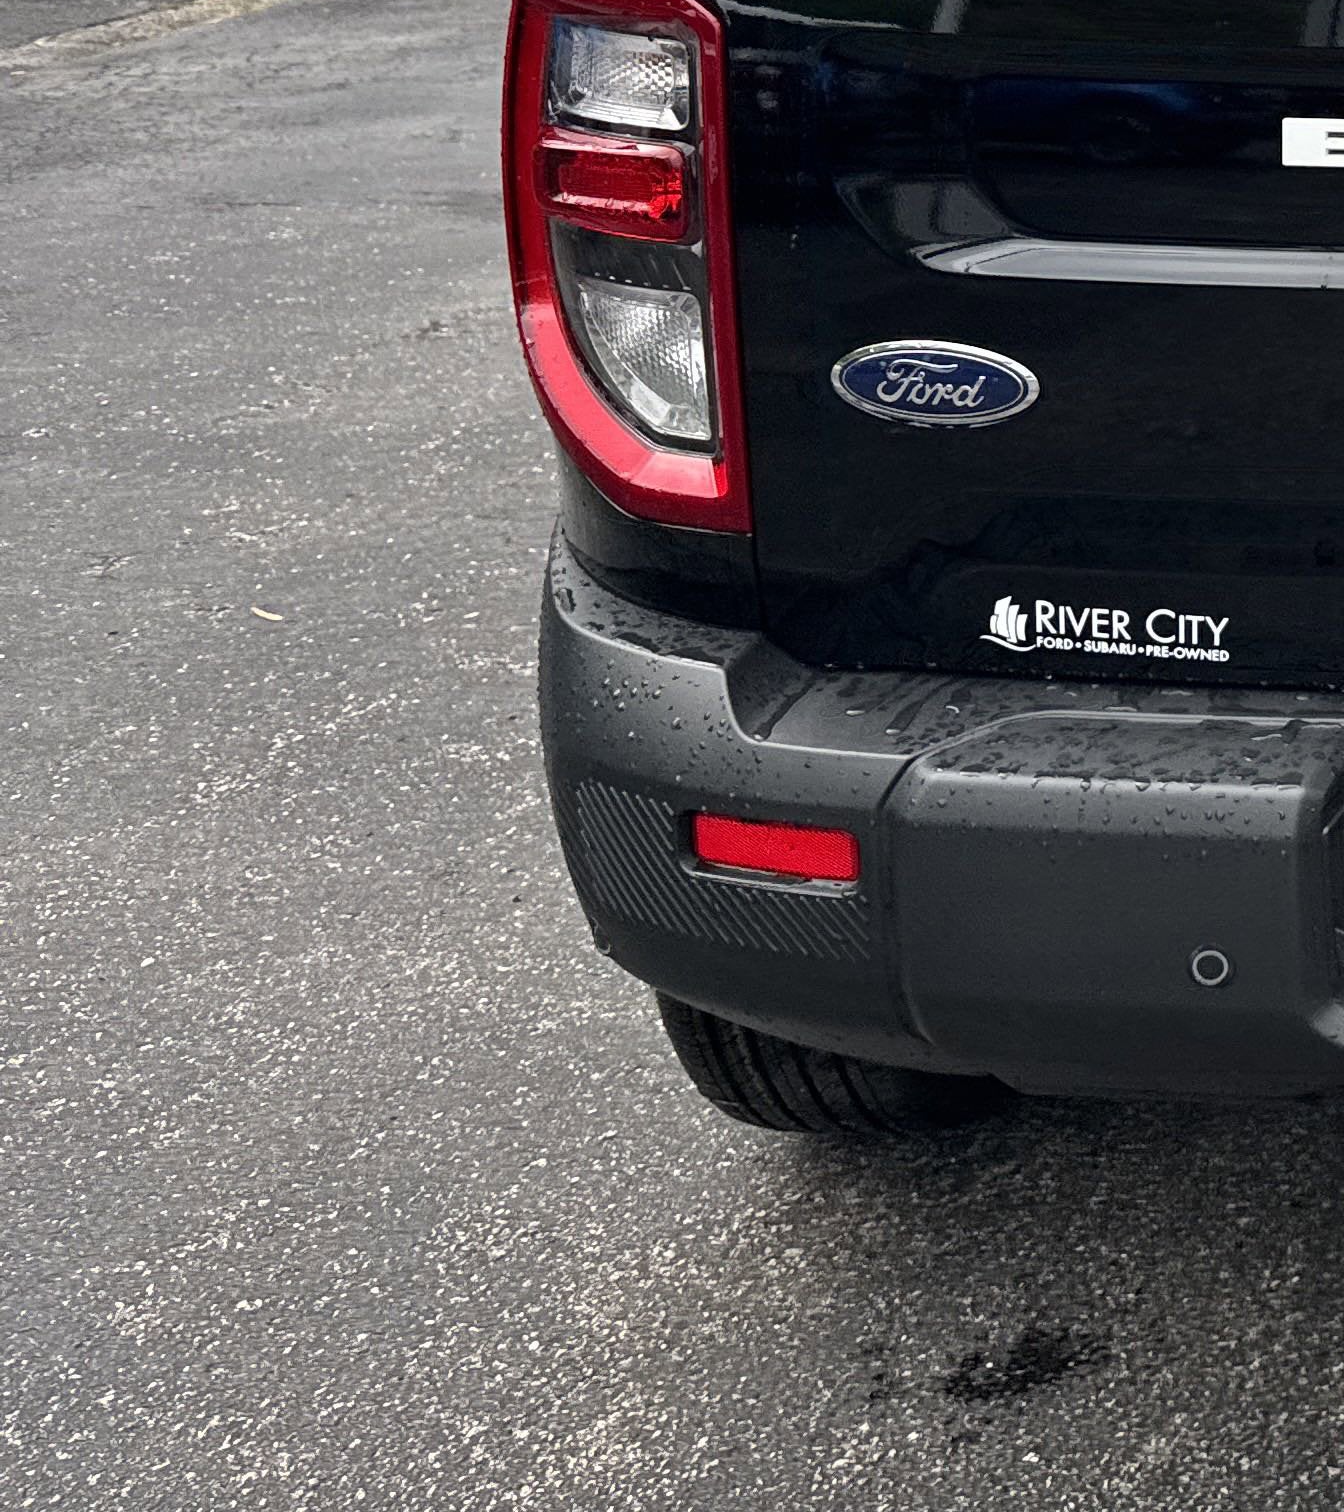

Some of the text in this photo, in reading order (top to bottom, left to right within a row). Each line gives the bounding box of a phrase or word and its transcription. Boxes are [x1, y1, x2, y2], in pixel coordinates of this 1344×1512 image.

[876, 358, 986, 408] Ford
[1035, 599, 1229, 647] RIVER CITY
[1036, 636, 1230, 662] FORD SUBARU PRE-OWNED
